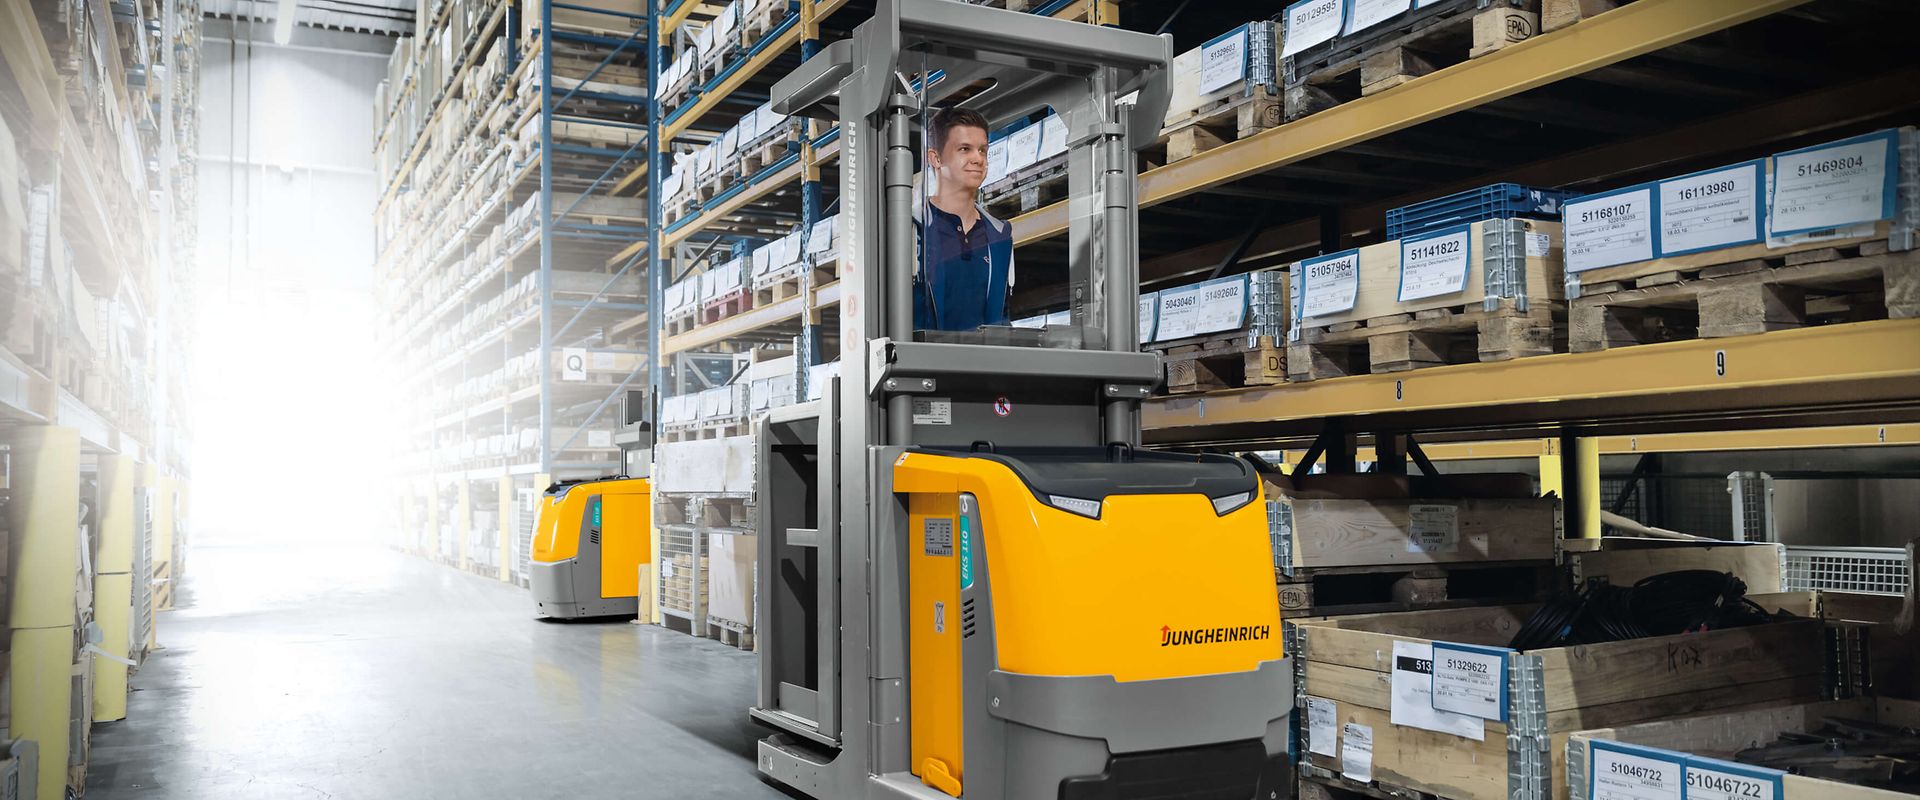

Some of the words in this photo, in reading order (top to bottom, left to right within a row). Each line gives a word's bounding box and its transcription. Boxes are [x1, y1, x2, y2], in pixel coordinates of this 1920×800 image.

[1296, 1, 1336, 25] 50129595
[1507, 20, 1528, 36] EPAL
[1798, 155, 1863, 177] 51469804
[1679, 180, 1735, 200] 16113980
[1582, 203, 1632, 222] 51168107
[1411, 240, 1459, 261] 51141822
[1311, 259, 1351, 278] 51057964
[1165, 295, 1196, 309] 50430461
[1206, 286, 1239, 301] 51492602
[567, 355, 583, 372] Q
[1717, 352, 1724, 376] 9
[1396, 381, 1402, 399] 8
[1161, 625, 1270, 646] JUNGHEINRICH
[1416, 660, 1432, 670] 513
[1447, 659, 1487, 673] 51329622
[1611, 762, 1662, 781] 51046722
[1687, 772, 1760, 798] 51046722
